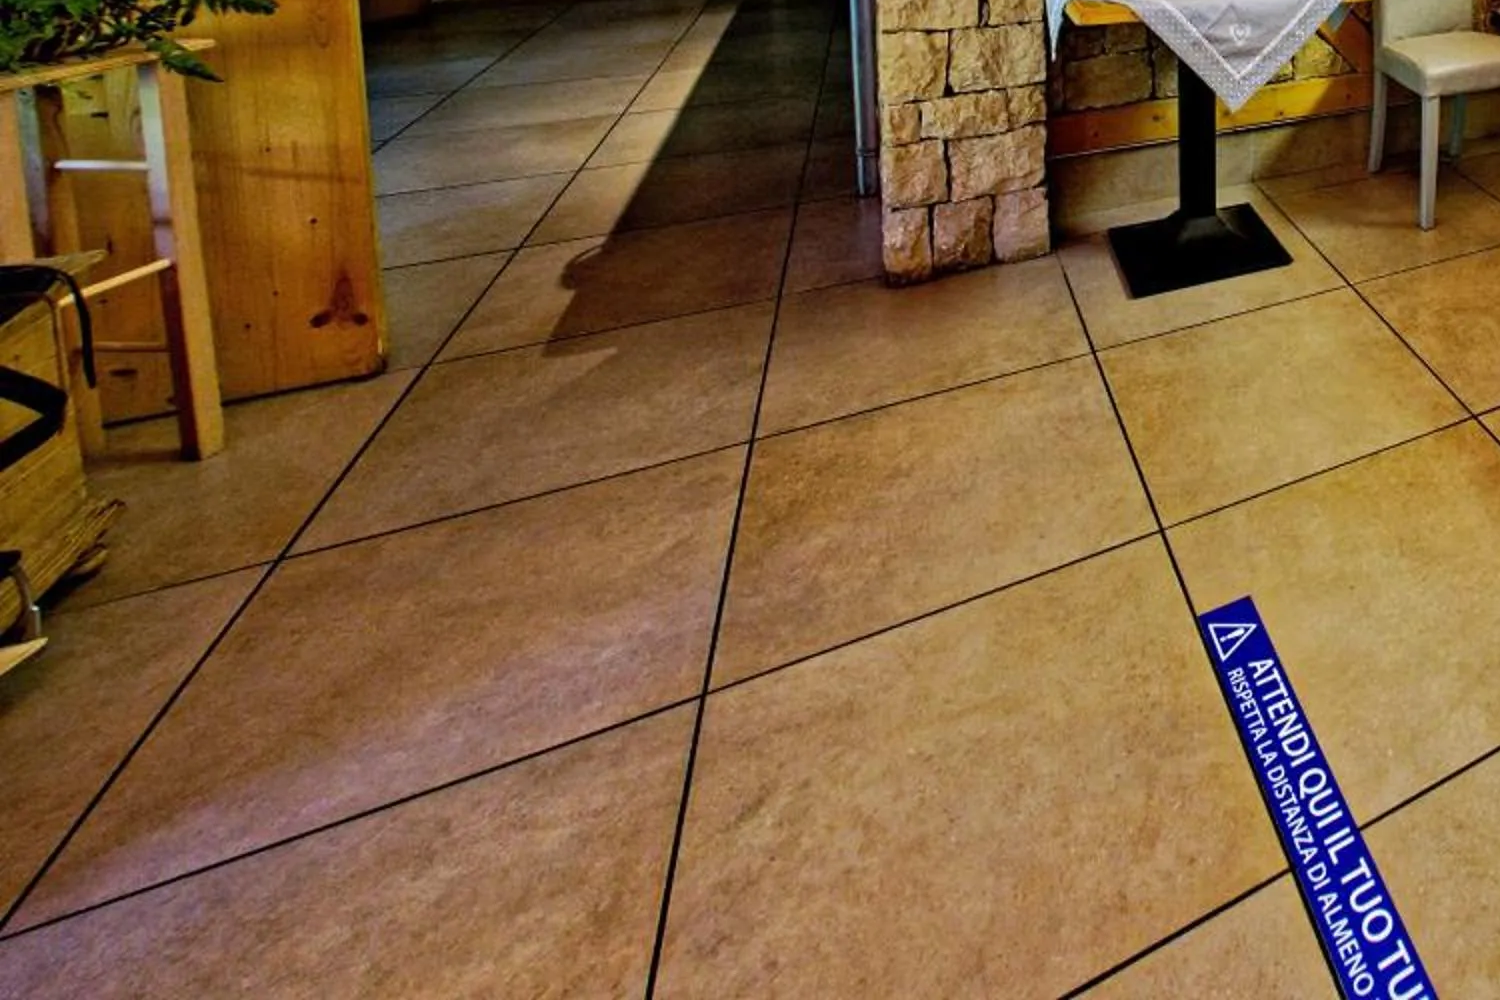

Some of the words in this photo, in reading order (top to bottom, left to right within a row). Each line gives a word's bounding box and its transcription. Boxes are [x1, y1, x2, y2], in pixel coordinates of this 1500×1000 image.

[1227, 667, 1268, 742] RISPETTA
[1256, 739, 1278, 767] LA
[1247, 659, 1316, 768] ATTENDI
[1299, 767, 1343, 829] QUI
[1323, 826, 1355, 865] IL
[1341, 857, 1394, 943] TUO
[1377, 938, 1430, 1000] TU
[1267, 764, 1318, 864] DISTANZA
[1306, 862, 1331, 891] DI
[1317, 893, 1375, 996] ALMENO
